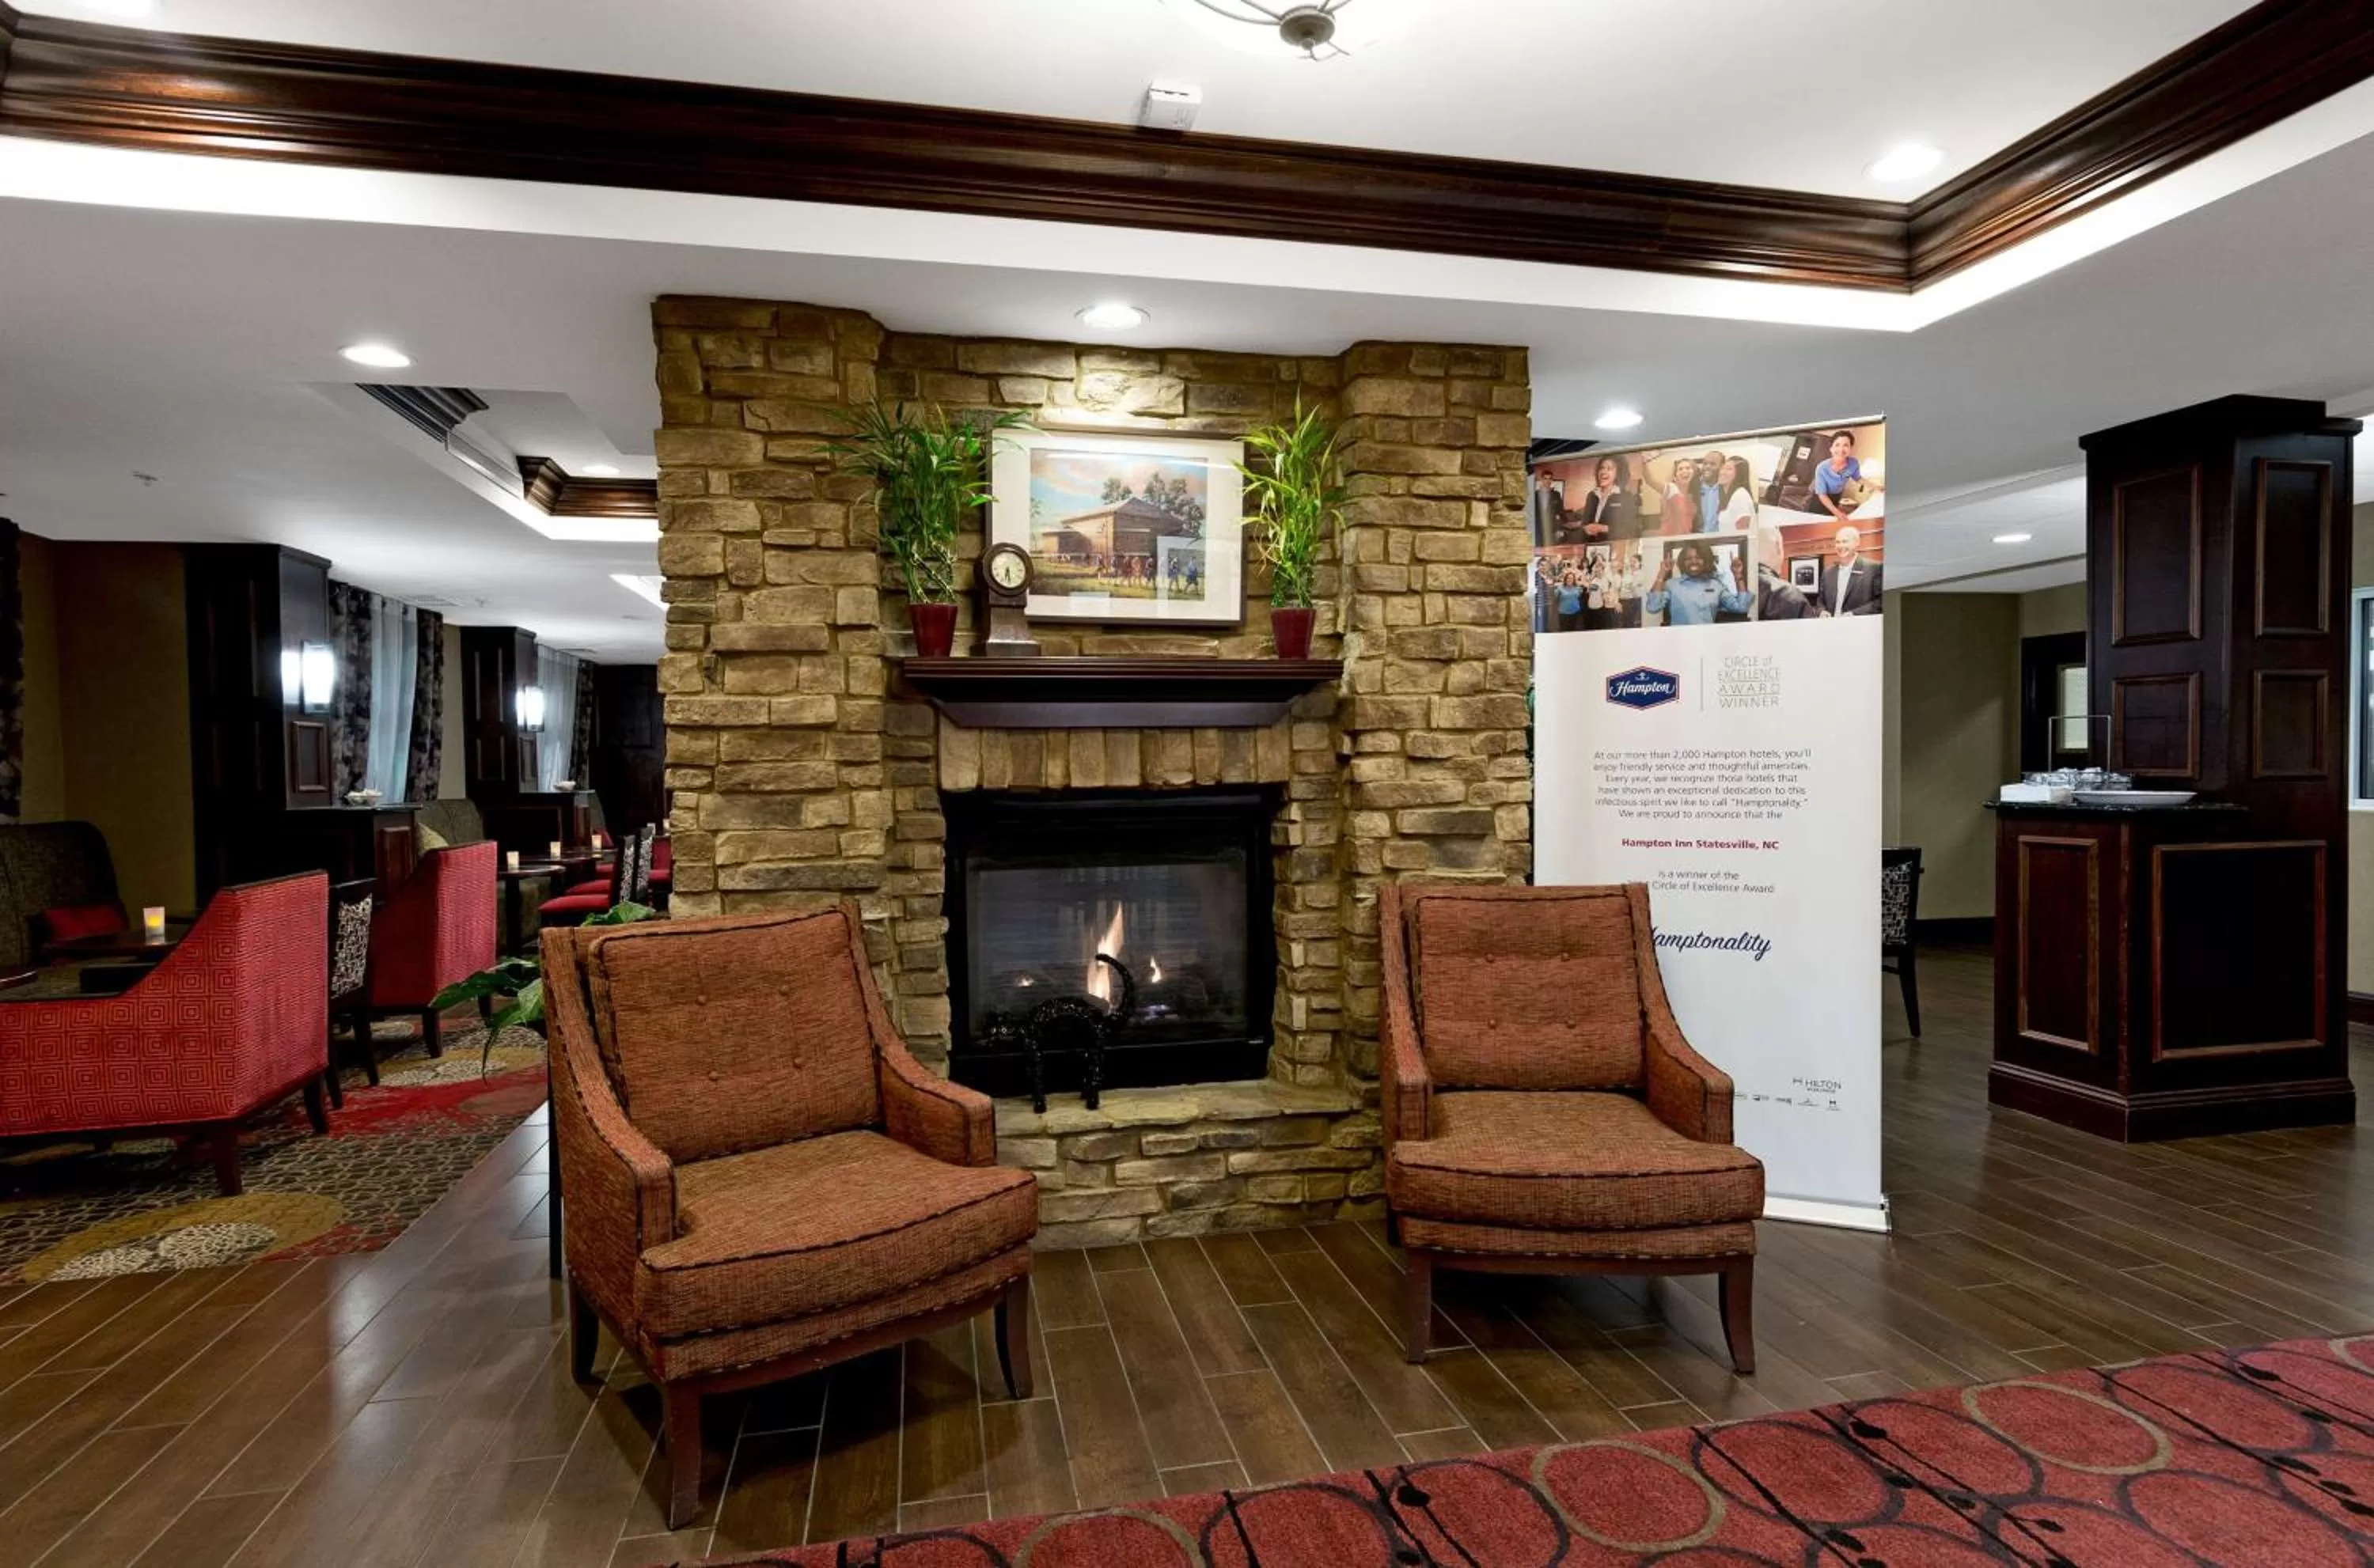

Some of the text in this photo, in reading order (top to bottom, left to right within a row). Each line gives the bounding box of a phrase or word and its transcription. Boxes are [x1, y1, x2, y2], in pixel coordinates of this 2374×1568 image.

[1724, 654, 1773, 668] CIRCLE of
[1718, 668, 1780, 683] EXCELLENCE
[1610, 680, 1675, 697] Hampton
[1720, 682, 1780, 695] AWARD
[1720, 696, 1779, 708] WINNER
[1595, 751, 1605, 759] At
[1606, 751, 1621, 759] our
[1650, 751, 1671, 759] than
[1673, 751, 1701, 759] 2,000
[1703, 751, 1746, 759] Hampton
[1750, 749, 1782, 759] hotels,
[1619, 763, 1653, 772] friendly
[1688, 763, 1705, 772] and
[1708, 761, 1759, 773] thoughtful
[1667, 786, 1720, 796] exceptional
[1724, 786, 1772, 795] dedication
[1775, 786, 1786, 795] to
[1618, 809, 1634, 818] We
[1652, 809, 1680, 818] proud
[1682, 809, 1693, 818] to
[1695, 810, 1742, 819] announce
[1743, 809, 1763, 818] that
[1766, 809, 1783, 818] the
[1621, 839, 1780, 850] Hampton Inn Statesville, NC
[1723, 871, 1739, 880] the
[1652, 881, 1678, 890] Circle
[1680, 881, 1689, 890] of
[1692, 881, 1740, 892] Excellence
[1743, 884, 1775, 893] Award
[1652, 926, 1772, 961] amptonality
[1805, 1078, 1841, 1089] HILTON
